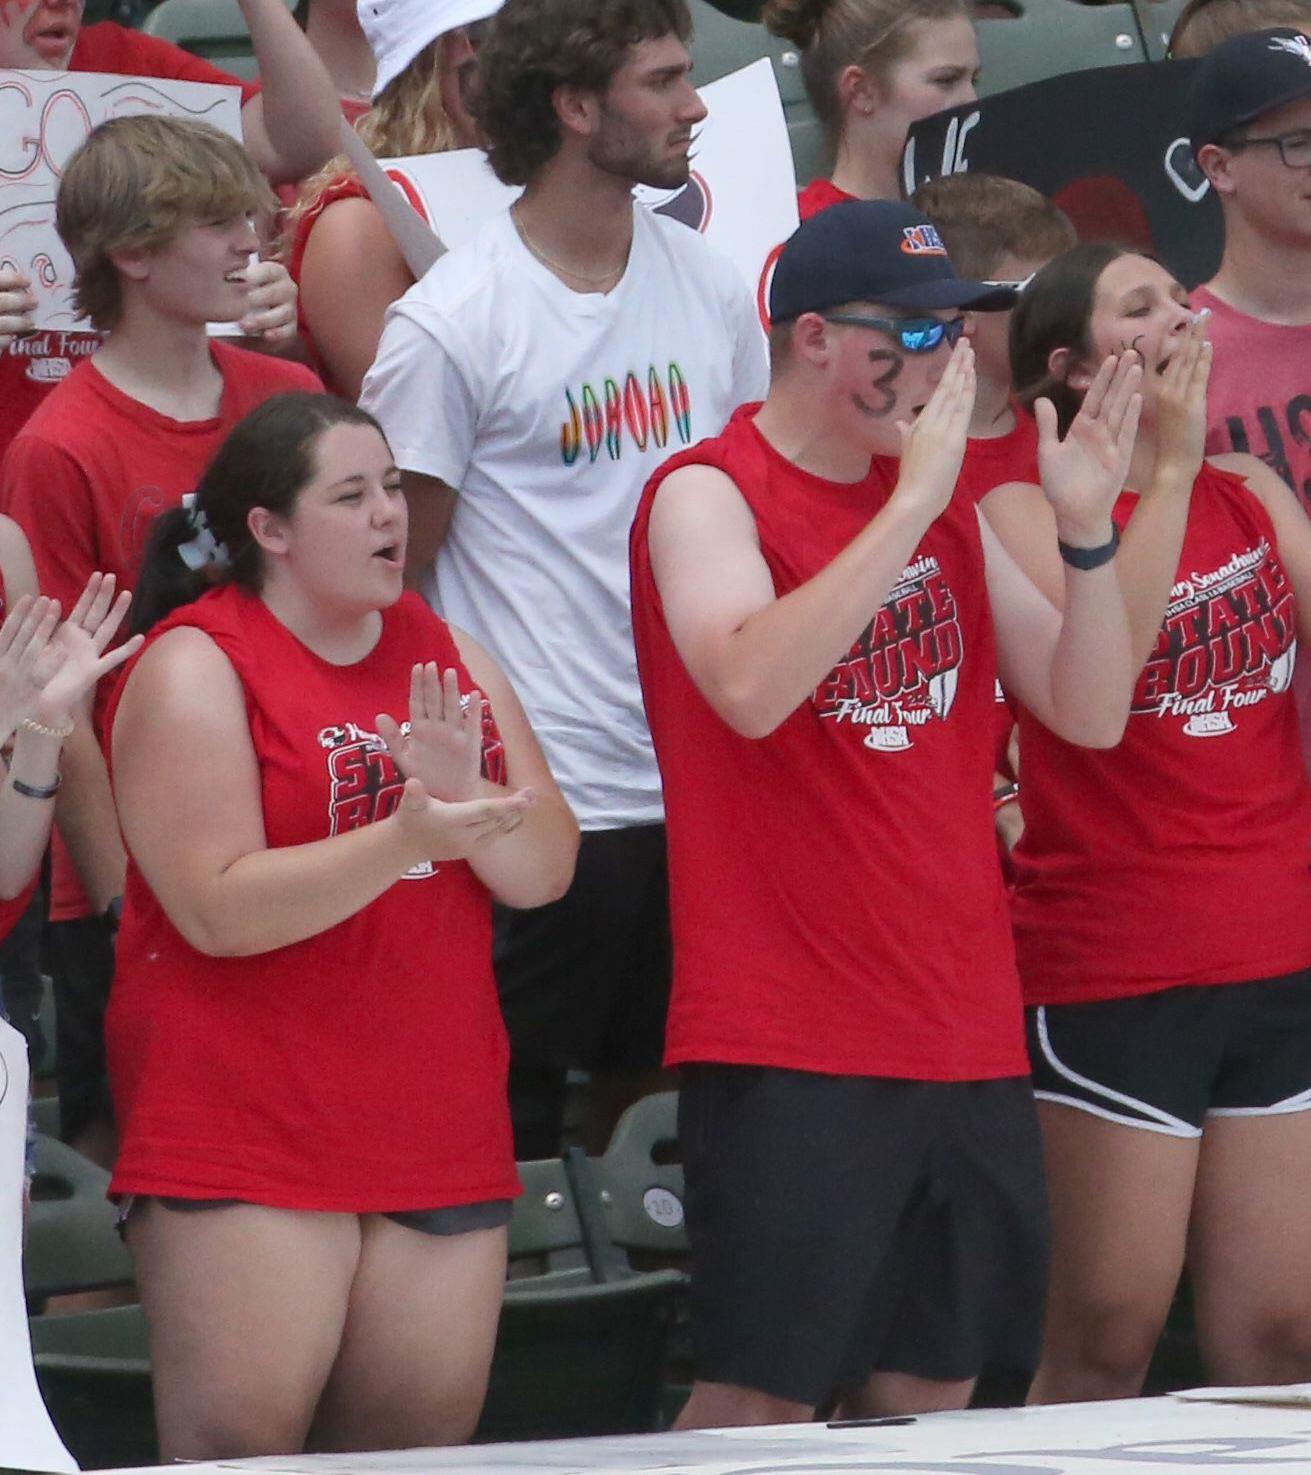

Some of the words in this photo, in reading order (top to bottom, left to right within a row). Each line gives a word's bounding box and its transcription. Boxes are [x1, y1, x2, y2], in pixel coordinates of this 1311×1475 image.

[853, 348, 904, 418] 3
[863, 576, 958, 653] ATE
[837, 698, 892, 725] Final
[892, 702, 933, 725] Four
[1158, 690, 1216, 718] Final
[1221, 685, 1268, 711] Four
[652, 1199, 671, 1216] 10
